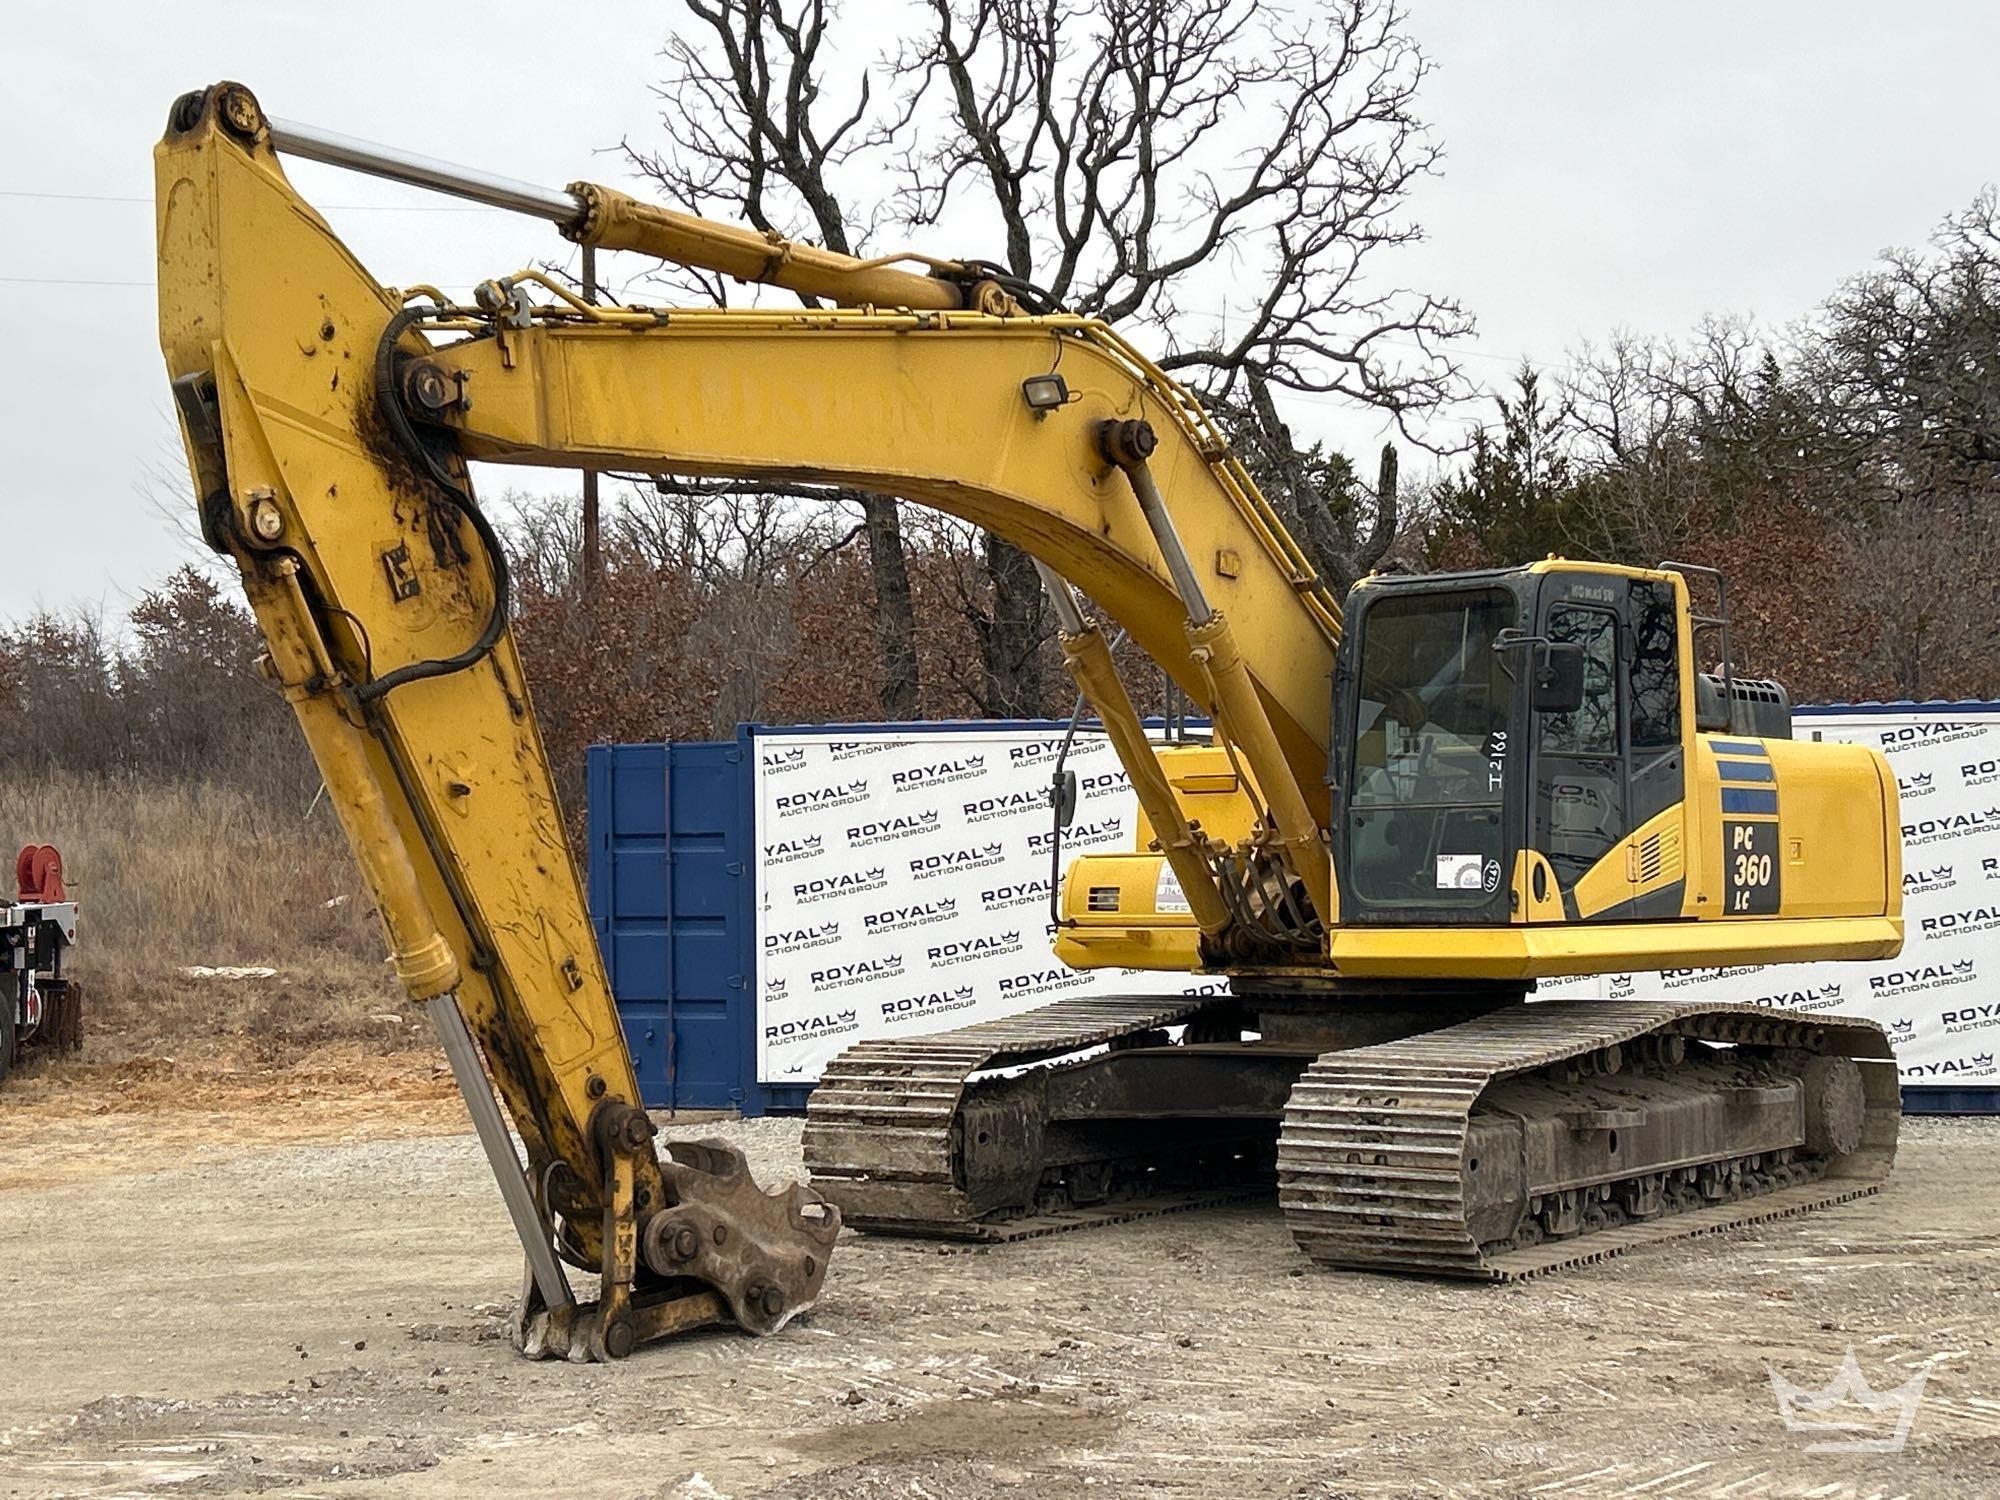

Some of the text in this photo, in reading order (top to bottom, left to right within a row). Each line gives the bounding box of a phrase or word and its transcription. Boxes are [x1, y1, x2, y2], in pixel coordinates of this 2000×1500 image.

[832, 745, 882, 761] AUCTION
[1884, 728, 1988, 754] AUCTION GROUP
[770, 762, 807, 776] GROUP
[892, 761, 966, 785] ROYAL
[895, 768, 987, 793] AUCTION GROUP
[776, 786, 849, 810] ROYAL
[779, 793, 870, 818] AUCTION GROUP
[963, 791, 1037, 815] ROYAL
[967, 801, 1053, 824] AUCTION GROU
[847, 815, 920, 840] ROYAL
[850, 823, 941, 848] AUCTION GROUP
[1901, 812, 1984, 838] ROYAL
[1031, 831, 1123, 856] AUCION GROUP
[1733, 826, 1753, 850] PC
[1904, 830, 1961, 847] AUCTION
[785, 848, 825, 862] GROUP
[910, 848, 984, 872] ROYAL
[913, 856, 1005, 880] AUCTION GROUP
[1734, 854, 1771, 886] 360
[794, 872, 866, 896] ROYAL
[796, 881, 888, 905] AUCTION GROUP
[1911, 880, 1957, 895] GROUP
[864, 903, 937, 927] ROYAL
[984, 896, 1035, 912] AUCTION
[867, 911, 959, 936] AUCTION GROUP
[1925, 924, 1982, 940] AUCTION
[803, 935, 842, 949] GROUP
[927, 936, 1001, 960] ROYAL
[930, 944, 1023, 969] AUCTION GROUP
[810, 960, 884, 984] ROYAL
[814, 968, 905, 992] AUCTION GROUP
[999, 968, 1073, 991] ROYAL
[1663, 974, 1718, 989] AUCTION
[1869, 965, 1953, 989] ROYAL
[1002, 976, 1095, 1000] AUCTION GROUP
[1873, 974, 1977, 998] AUCTION GROUP
[881, 991, 954, 1015] ROYAL
[884, 1000, 976, 1024] AUCTION GROUP
[1800, 998, 1844, 1012] GROUP
[766, 1015, 838, 1039] ROYAL
[768, 1023, 859, 1047] AUCTION GROUP
